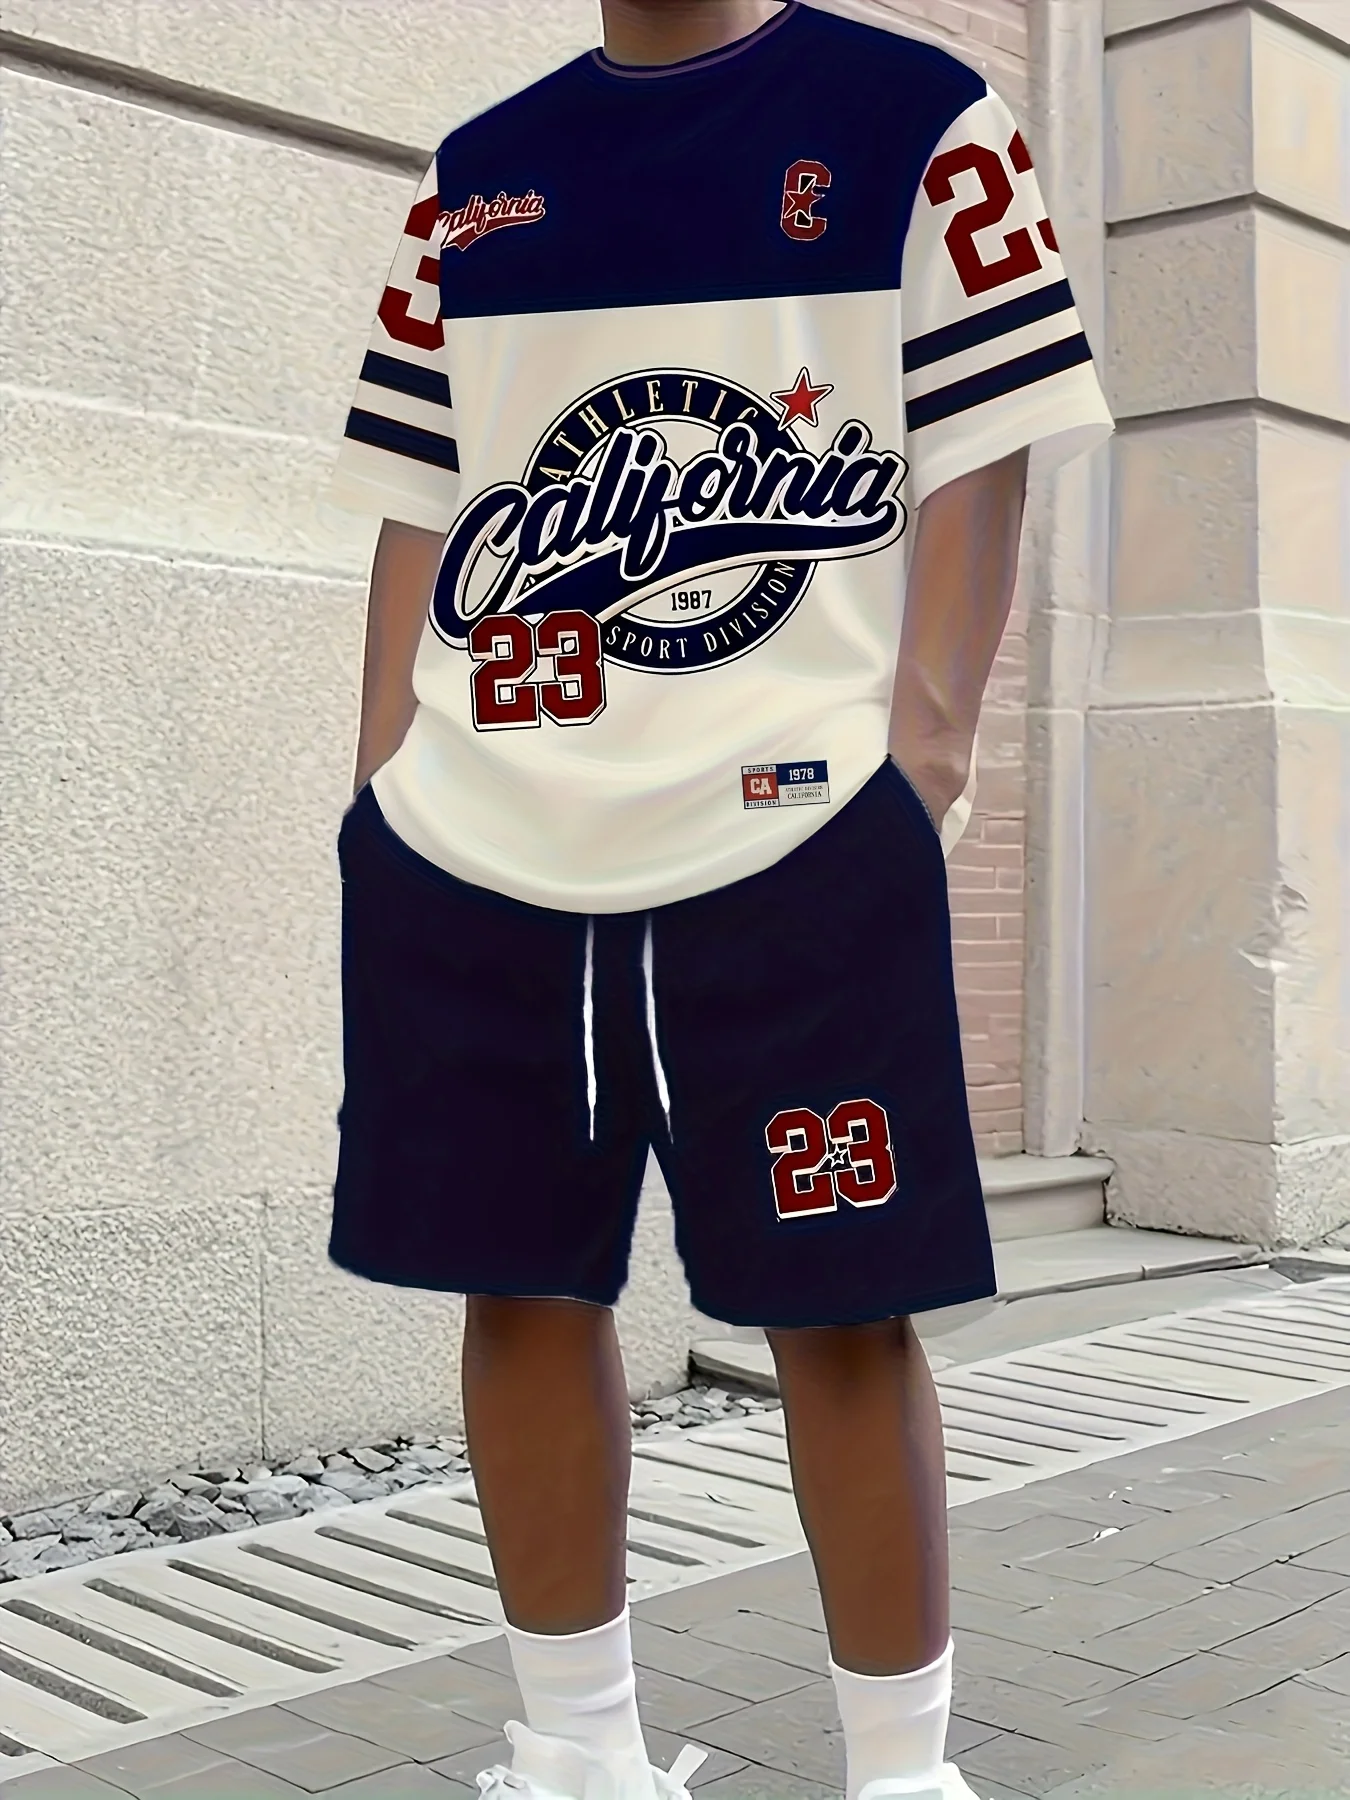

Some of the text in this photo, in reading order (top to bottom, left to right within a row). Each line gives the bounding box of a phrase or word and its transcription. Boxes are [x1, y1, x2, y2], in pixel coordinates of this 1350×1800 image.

[428, 419, 909, 650] California
[606, 561, 796, 660] SPORT DIVISION
[671, 589, 712, 611] 1987
[469, 610, 607, 732] 23
[747, 766, 774, 774] SPORTS
[789, 768, 815, 781] 1978
[750, 777, 773, 795] CA
[746, 800, 776, 808] DIVISION
[765, 1098, 898, 1220] 23
